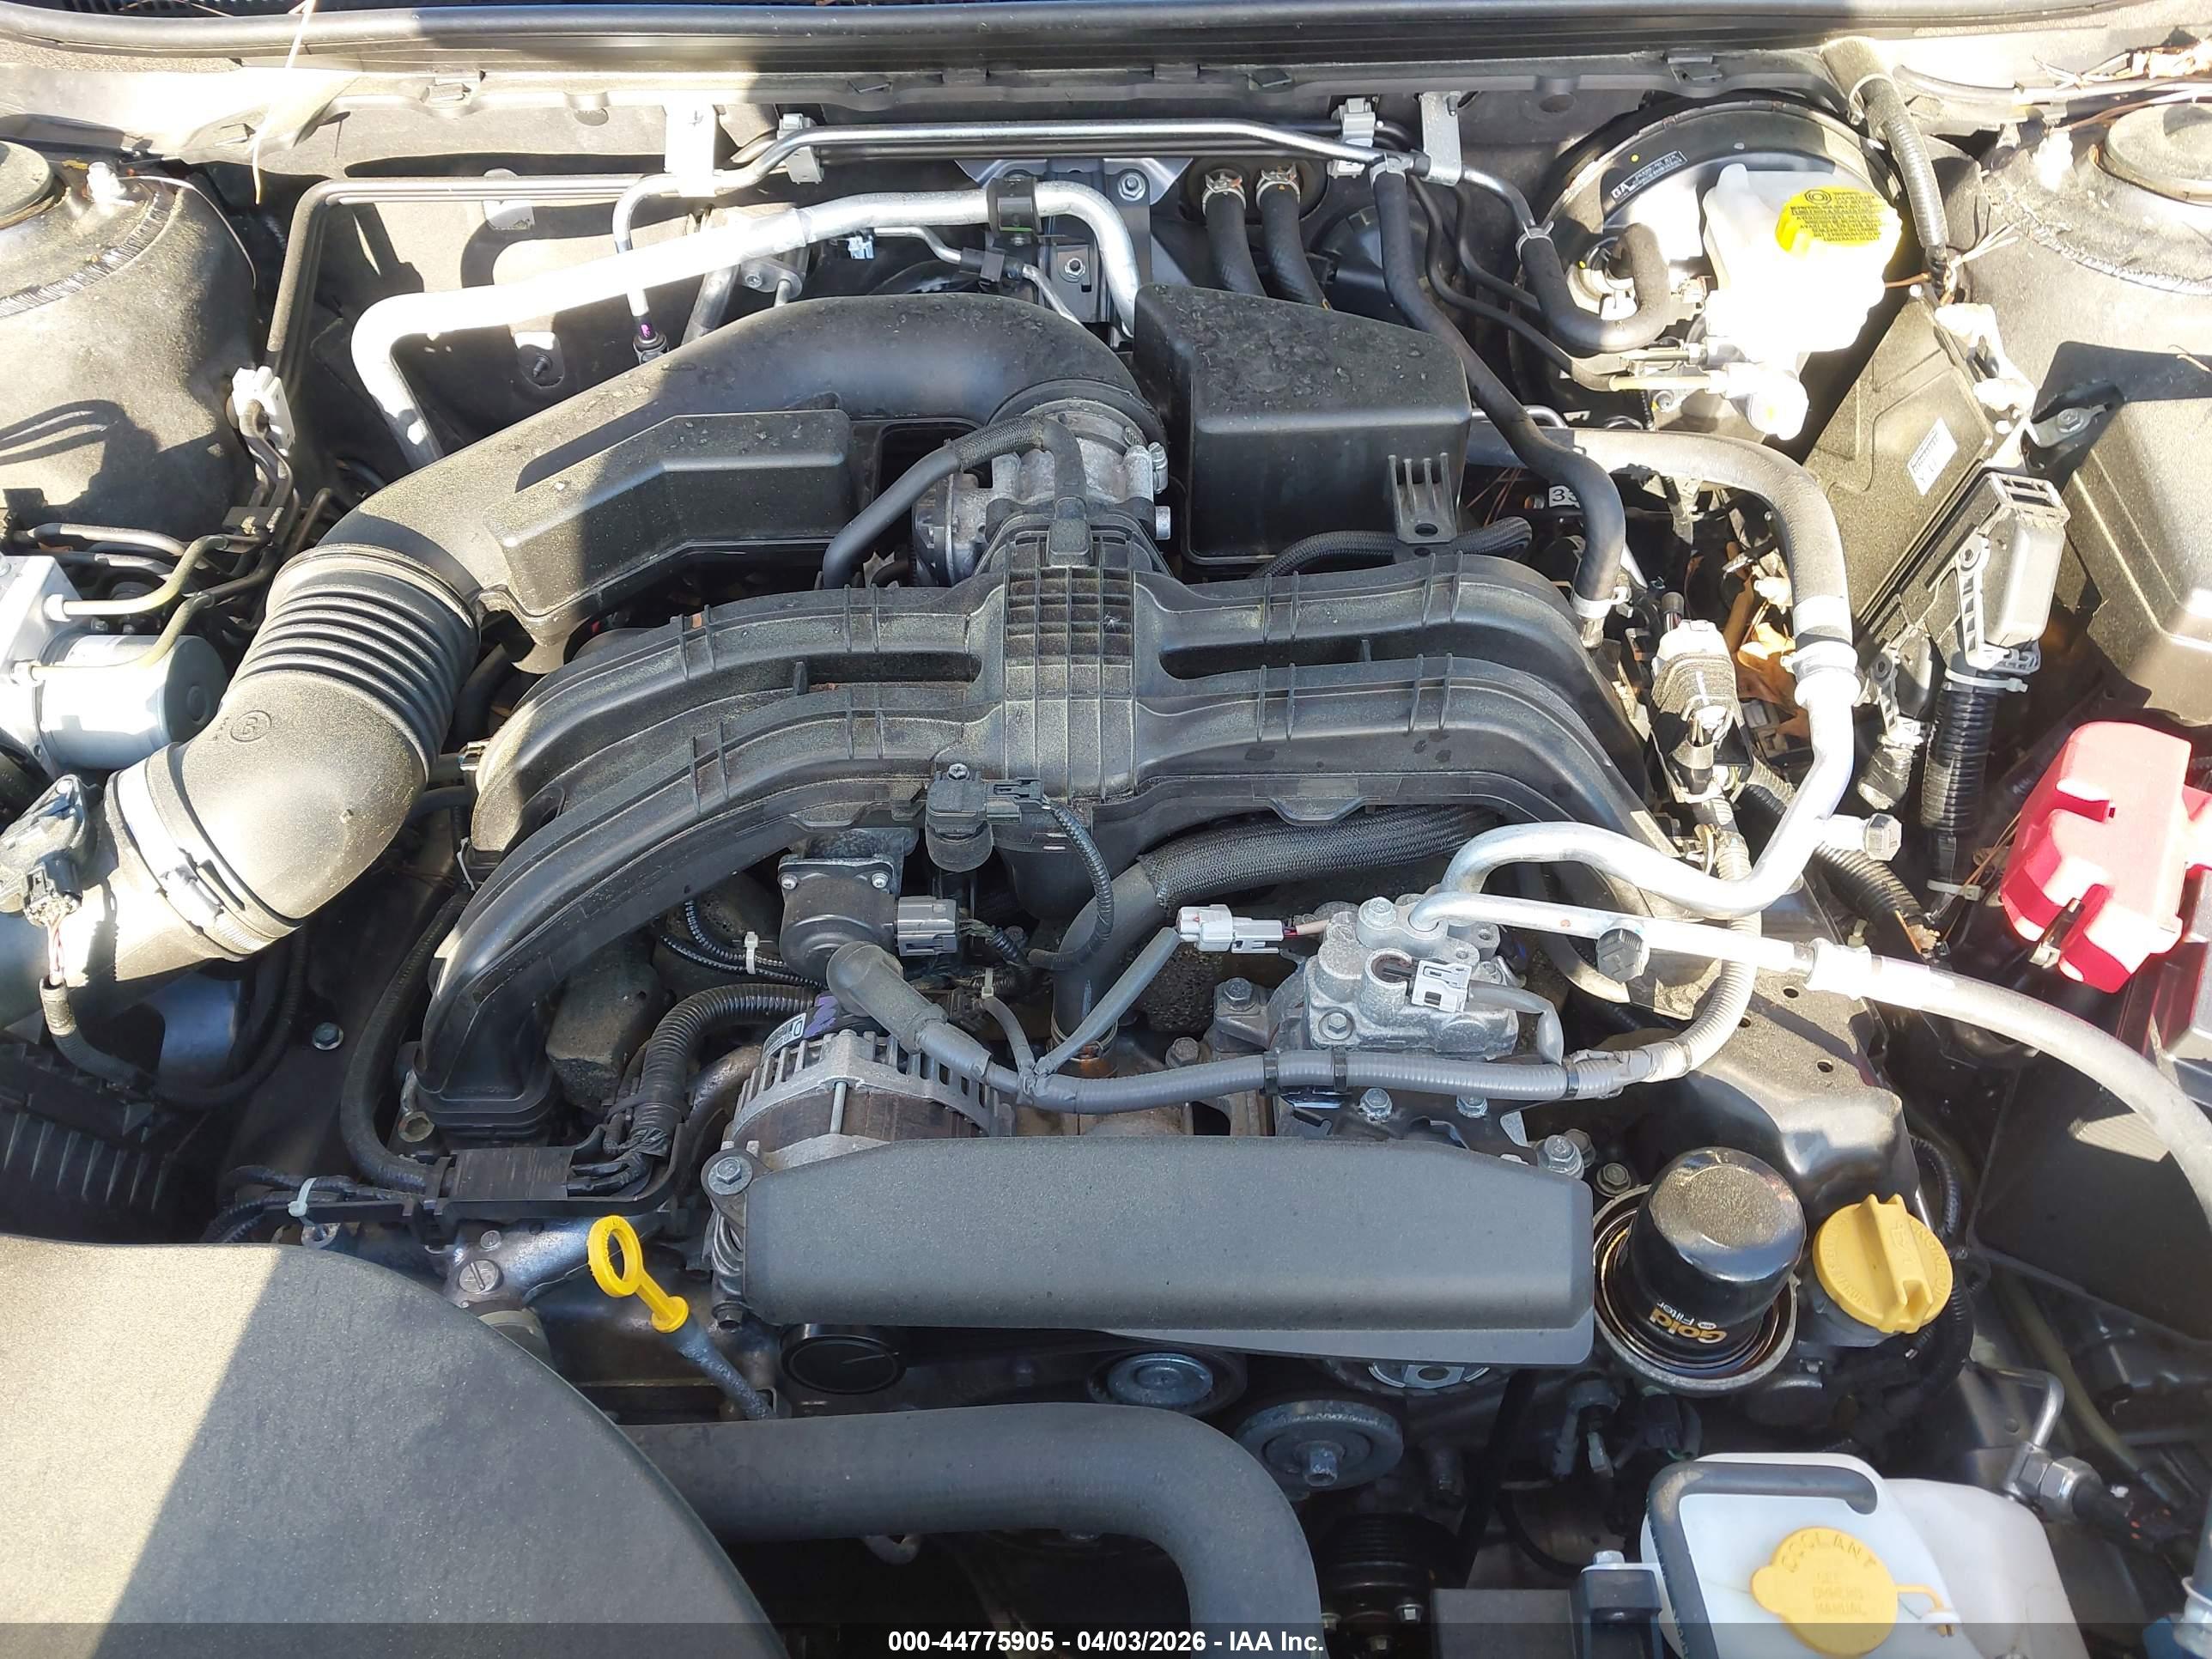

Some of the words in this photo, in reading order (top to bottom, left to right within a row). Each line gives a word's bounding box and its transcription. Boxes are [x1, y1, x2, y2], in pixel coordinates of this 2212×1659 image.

[1649, 1306, 1728, 1344] Gold
[1656, 1301, 1695, 1327] Filter
[1781, 1532, 1878, 1573] COOLANT
